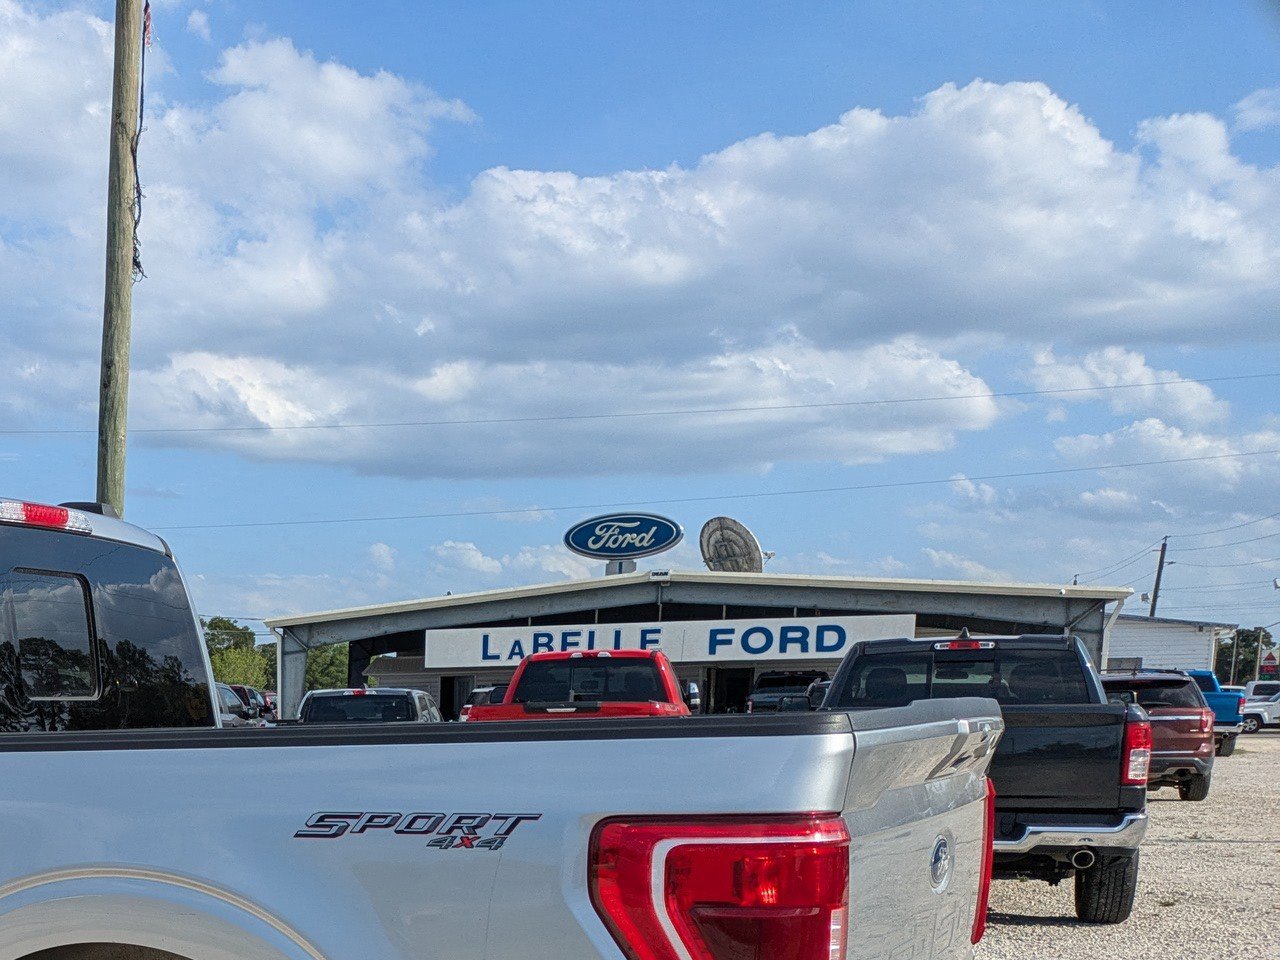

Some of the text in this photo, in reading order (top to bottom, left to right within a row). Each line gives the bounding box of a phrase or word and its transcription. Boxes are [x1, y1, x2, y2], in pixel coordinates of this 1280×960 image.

[588, 521, 658, 550] Ford
[708, 624, 847, 655] FORD
[293, 811, 543, 838] SPORT
